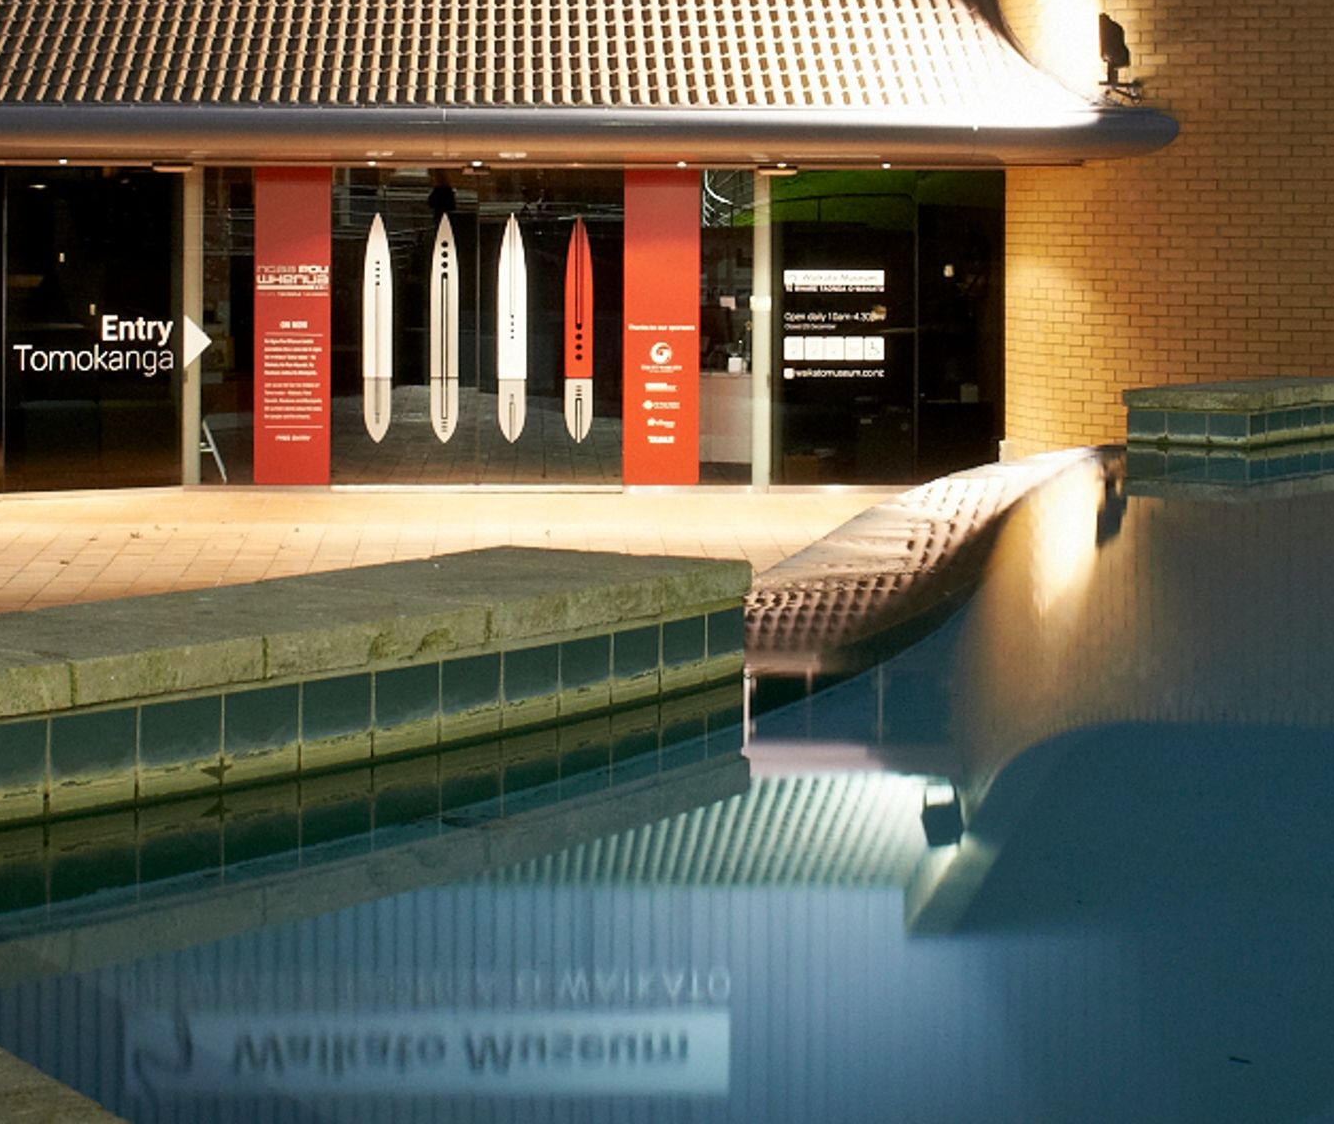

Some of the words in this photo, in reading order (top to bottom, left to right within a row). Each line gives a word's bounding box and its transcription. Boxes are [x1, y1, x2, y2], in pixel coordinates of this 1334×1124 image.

[102, 315, 174, 347] Entry
[784, 312, 806, 323] Open
[807, 312, 827, 323] daily
[13, 344, 174, 377] Tomokanga
